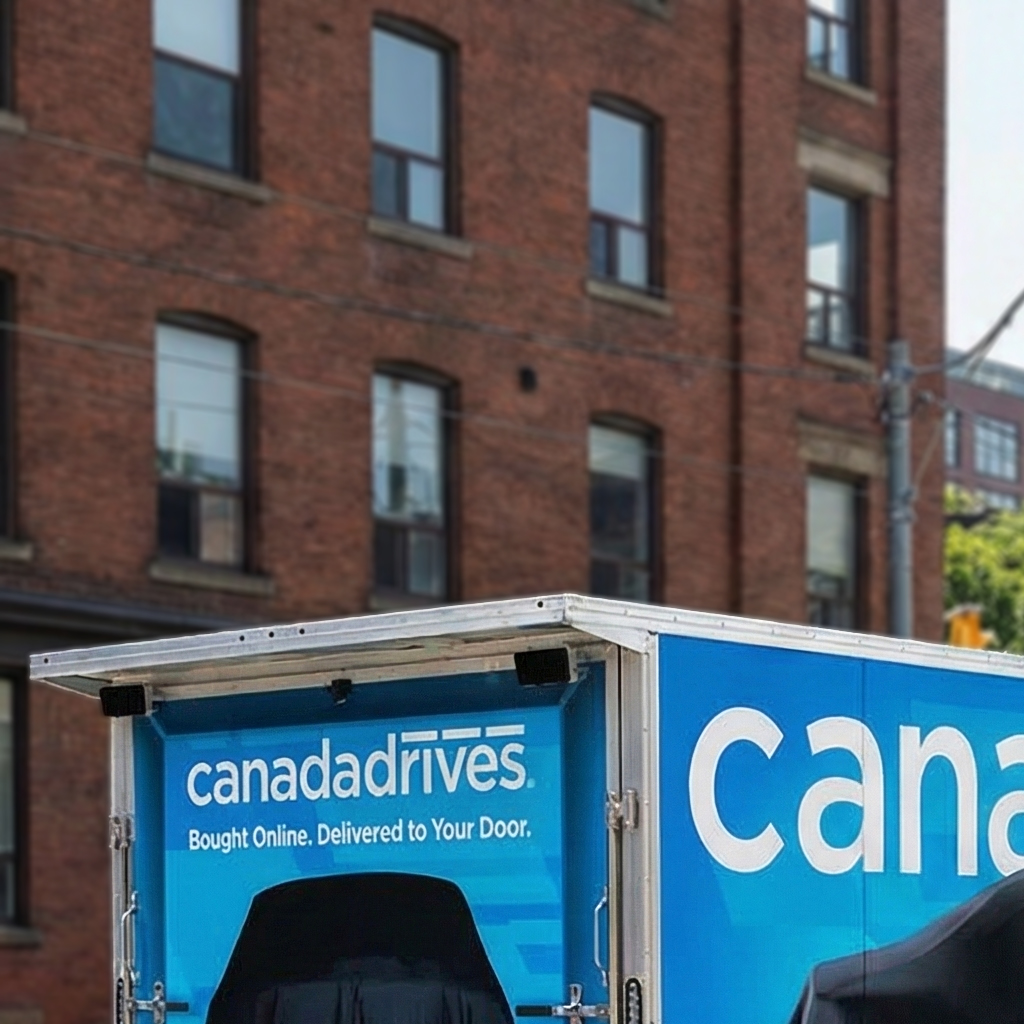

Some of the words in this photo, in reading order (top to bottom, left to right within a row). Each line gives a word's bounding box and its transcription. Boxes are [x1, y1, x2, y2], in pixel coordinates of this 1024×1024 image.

[186, 724, 527, 806] canadadrives
[188, 824, 249, 853] Bought
[252, 824, 313, 847] Online.
[317, 817, 404, 846] Delivered
[407, 820, 427, 842] to
[431, 817, 475, 841] Your
[479, 815, 531, 839] Door.
